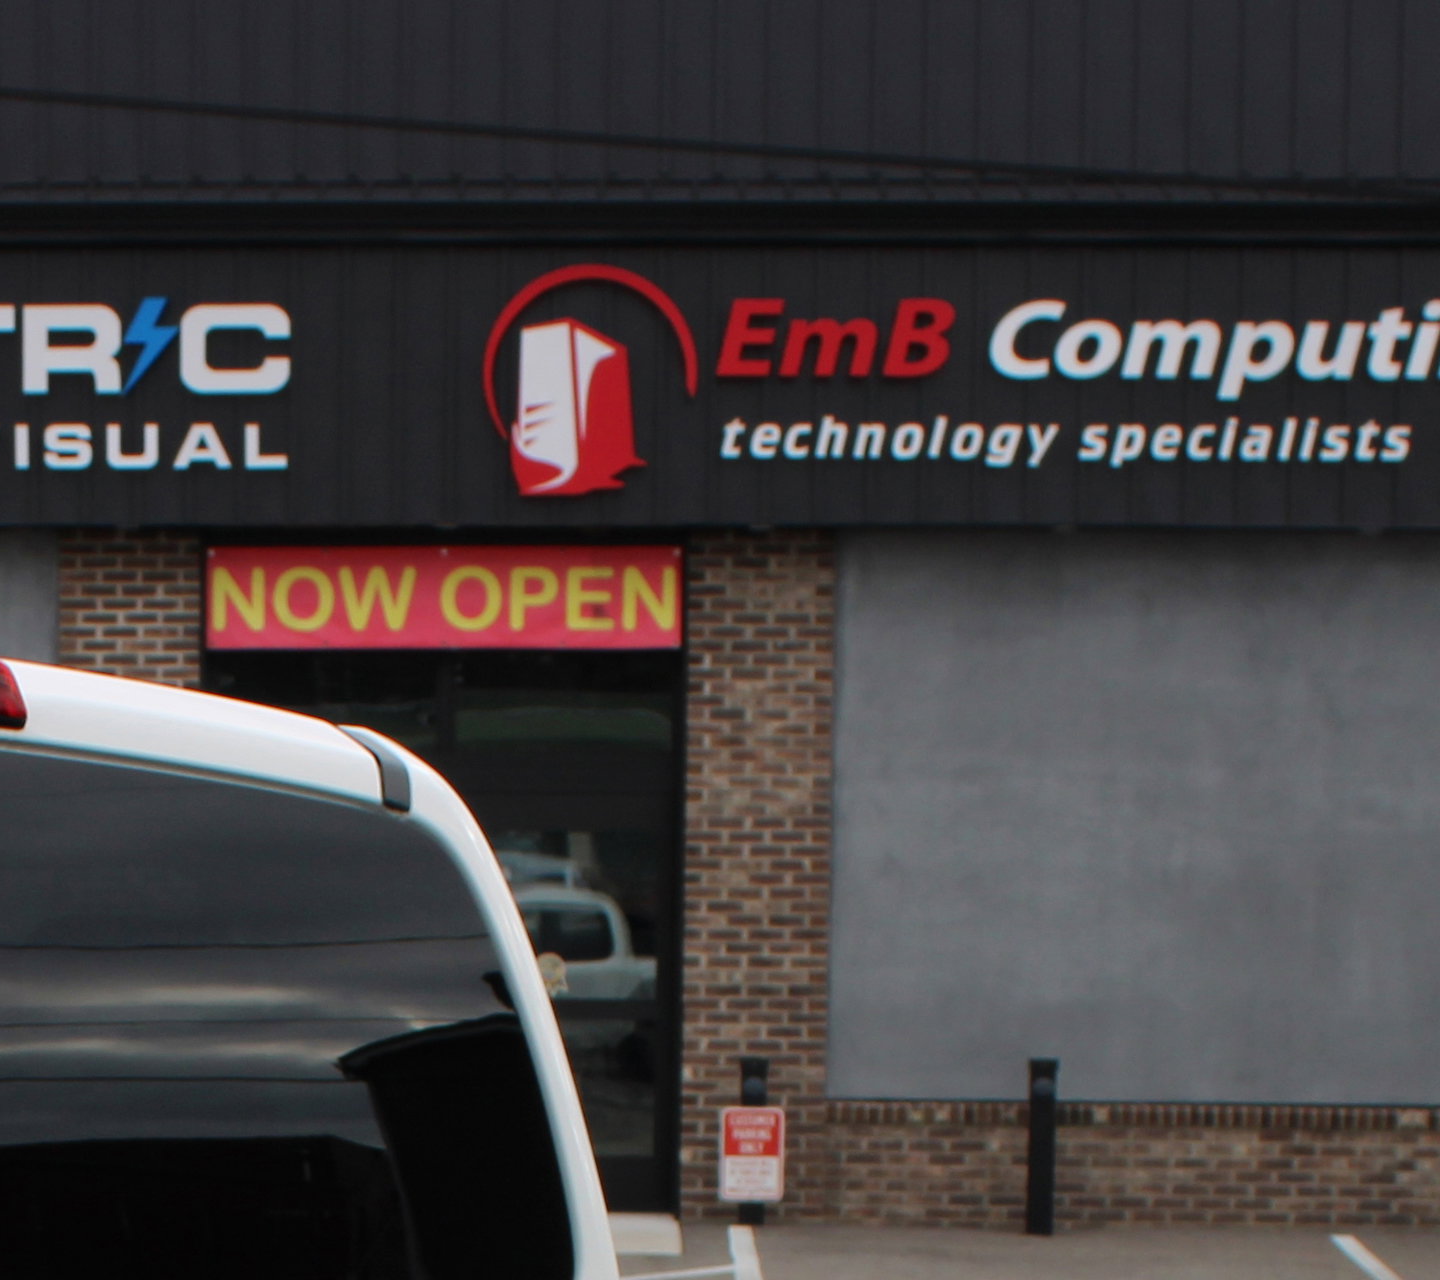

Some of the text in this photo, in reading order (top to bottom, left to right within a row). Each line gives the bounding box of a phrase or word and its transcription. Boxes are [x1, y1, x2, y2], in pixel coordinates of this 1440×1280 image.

[716, 298, 956, 378] EmB
[720, 414, 1413, 468] technology specialists
[211, 564, 677, 632] NOW OPEN
